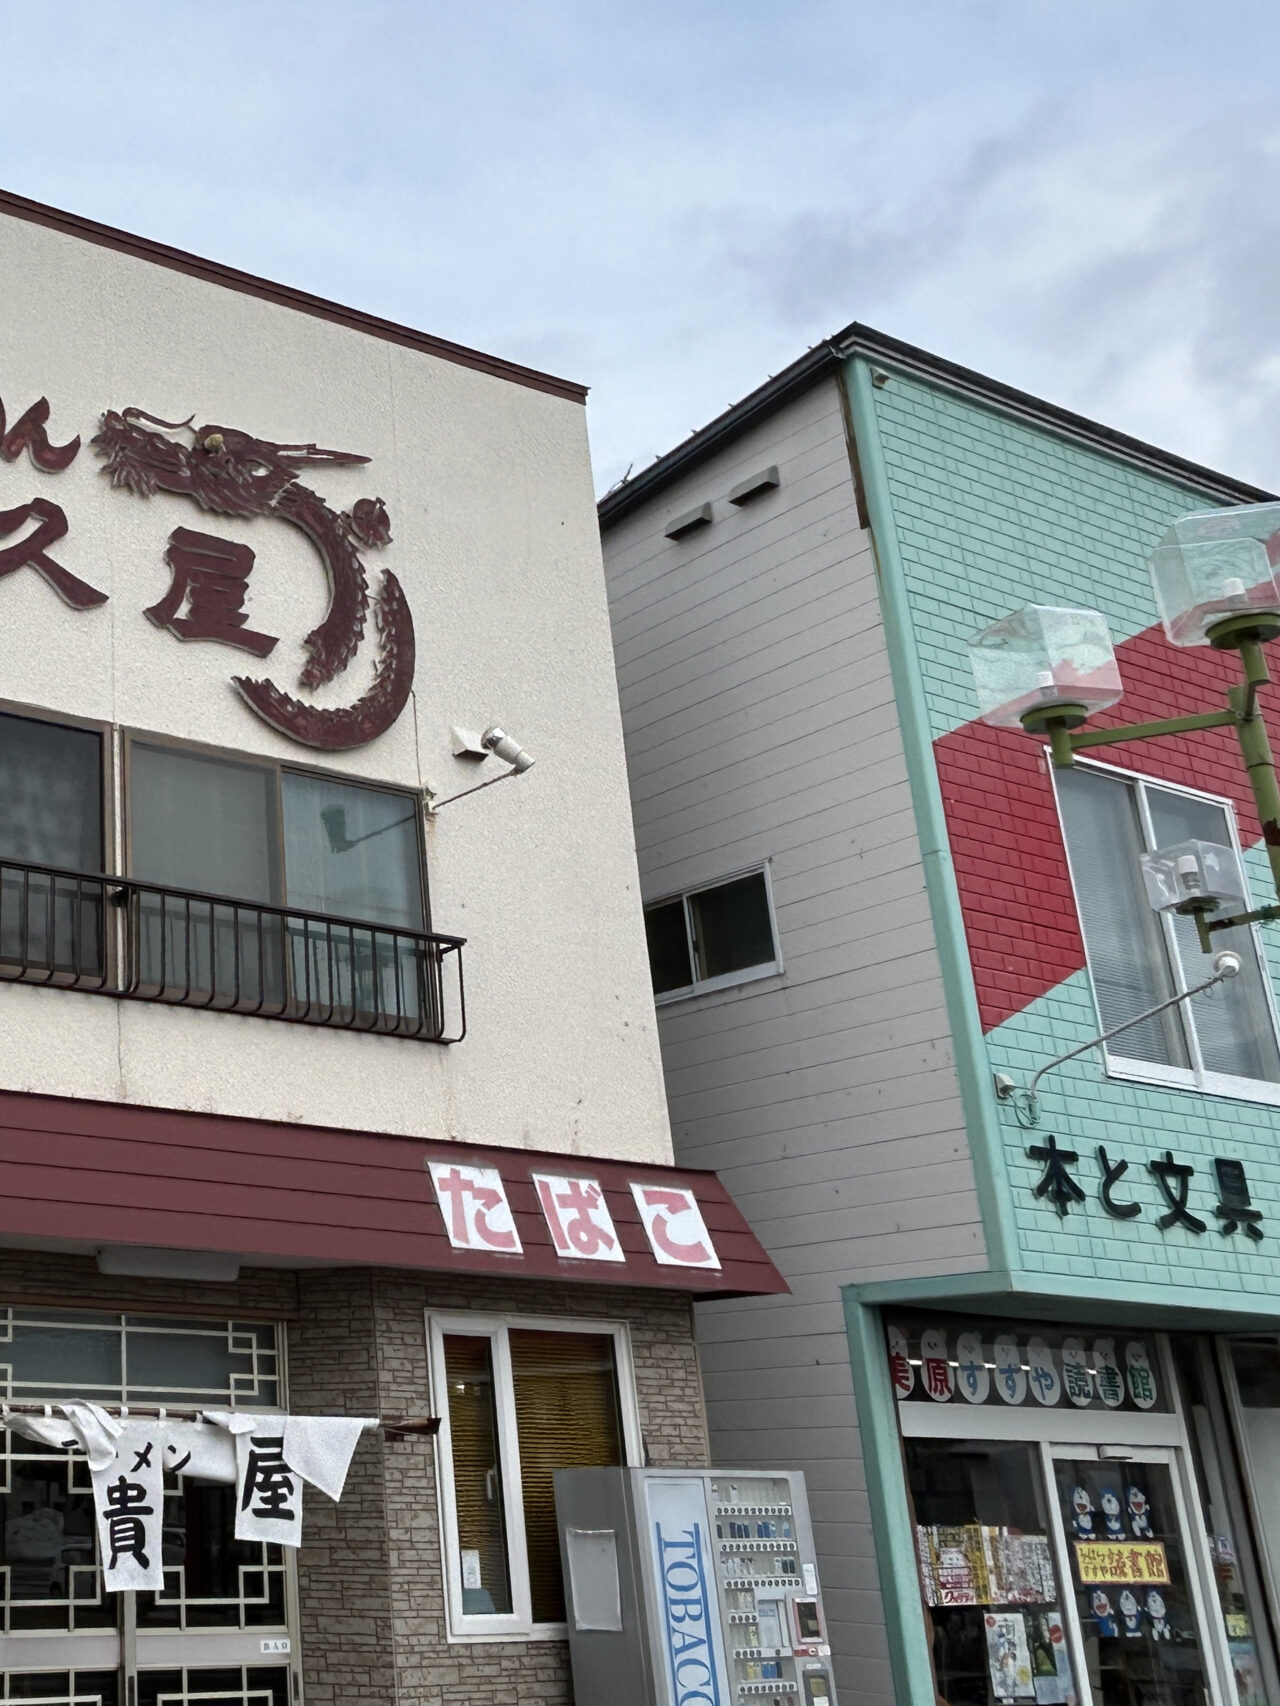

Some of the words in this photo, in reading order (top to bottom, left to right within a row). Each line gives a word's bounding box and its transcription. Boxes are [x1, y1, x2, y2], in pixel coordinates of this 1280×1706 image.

[437, 1167, 713, 1264] たばこ
[1026, 1134, 1265, 1241] 本と文具
